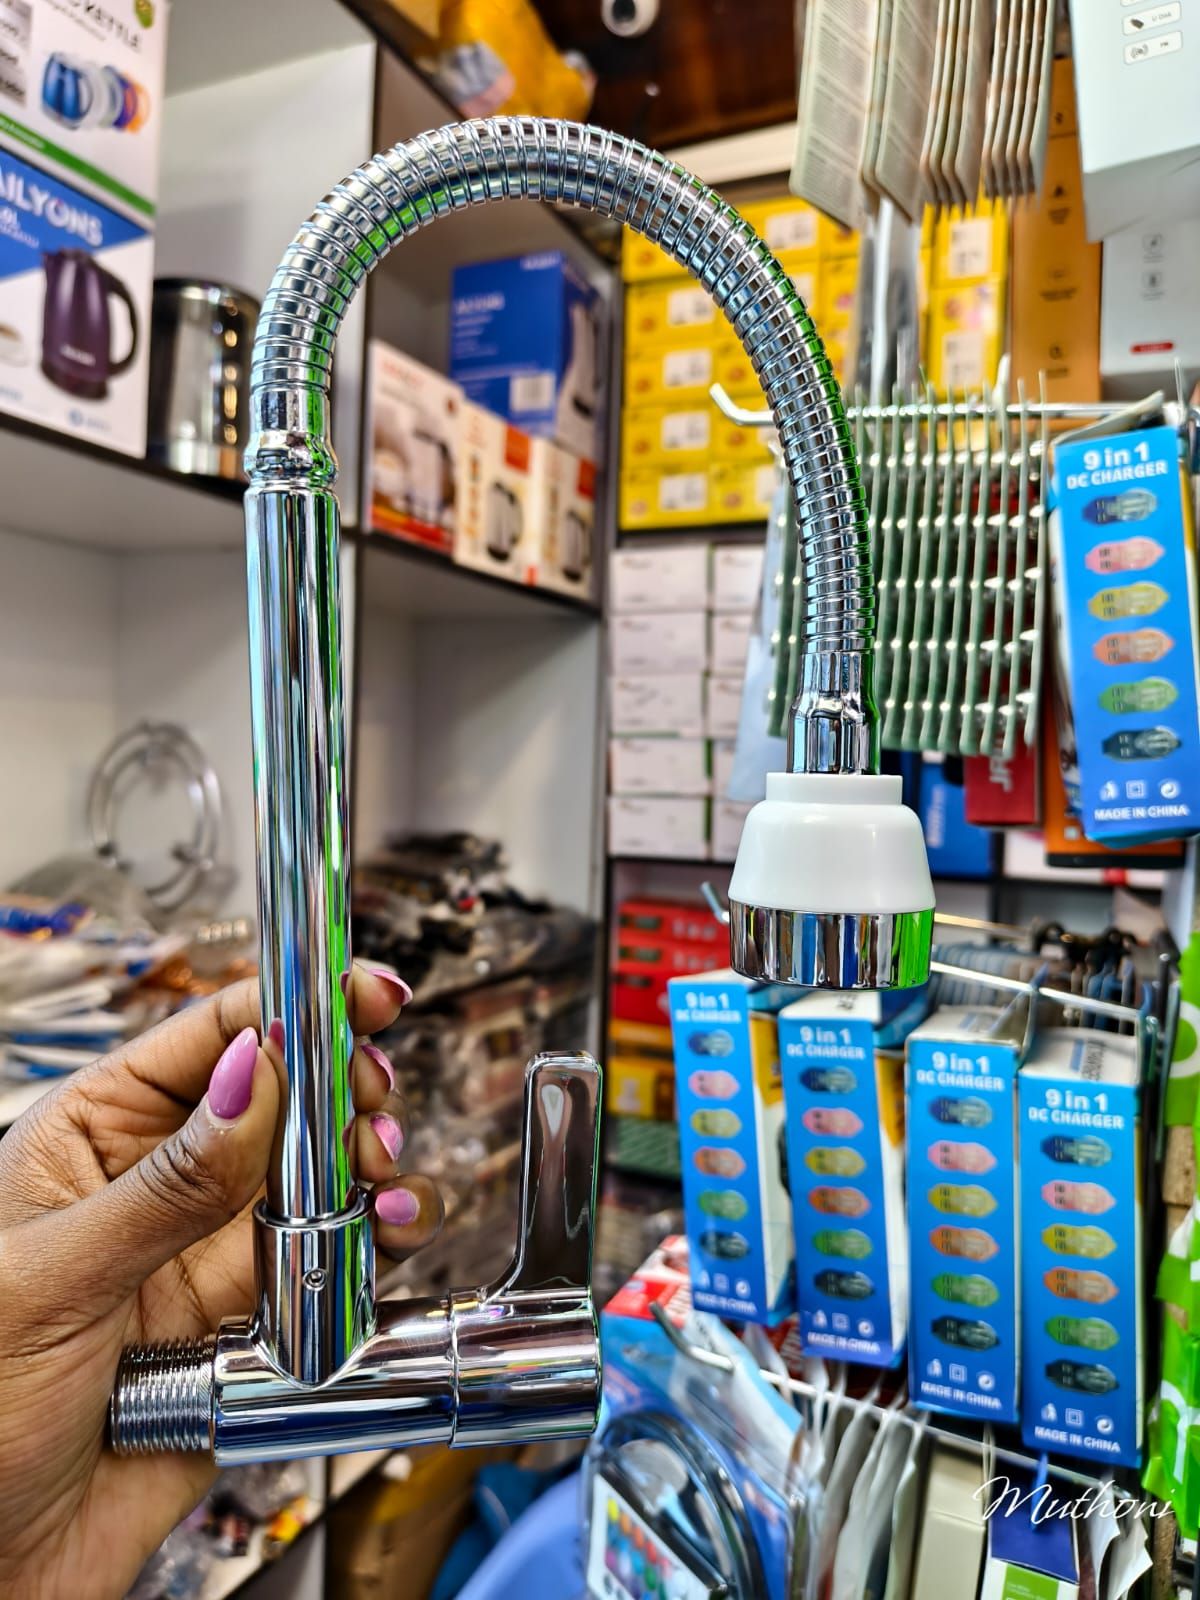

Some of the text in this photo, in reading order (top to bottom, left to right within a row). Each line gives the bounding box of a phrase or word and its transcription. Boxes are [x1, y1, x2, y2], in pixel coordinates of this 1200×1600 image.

[1083, 441, 1151, 471] 9 in 1
[1066, 459, 1169, 490] DC CHARGER
[1094, 804, 1189, 820] MADE IN CHINA
[800, 1025, 814, 1044] 9
[839, 1027, 852, 1045] 1
[932, 1051, 991, 1075] 9 in 1
[916, 1069, 1005, 1092] DC CHARGER
[1045, 1088, 1108, 1113] 9 in 1
[1028, 1106, 1125, 1130] DC CHARGER
[1034, 1425, 1121, 1453] MADE IN CHINA
